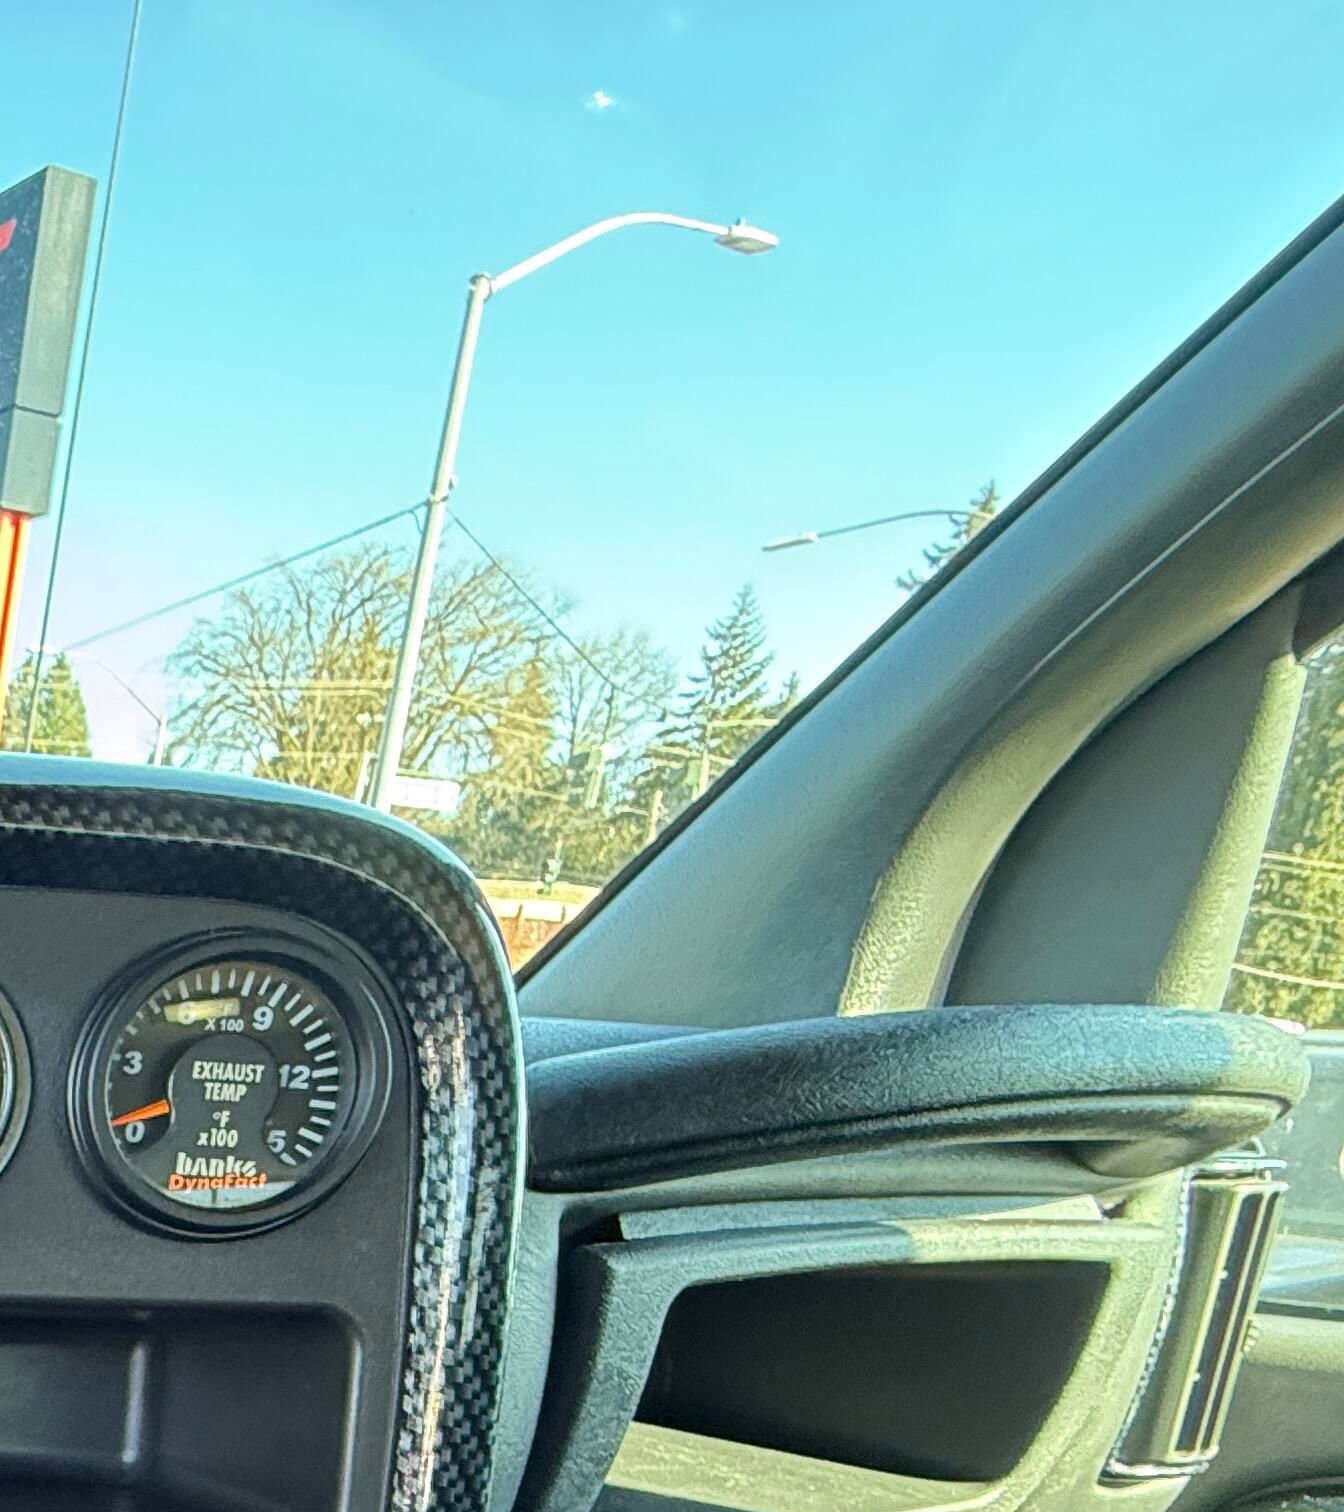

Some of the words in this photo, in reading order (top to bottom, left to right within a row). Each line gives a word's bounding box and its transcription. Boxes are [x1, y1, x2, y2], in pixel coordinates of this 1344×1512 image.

[251, 1005, 275, 1032] 9
[122, 1050, 144, 1076] 3
[191, 1060, 265, 1084] EXHAUST
[278, 1064, 311, 1091] 12
[204, 1082, 248, 1103] TEMP
[124, 1121, 146, 1144] 0
[168, 1172, 268, 1194] DynaFact
